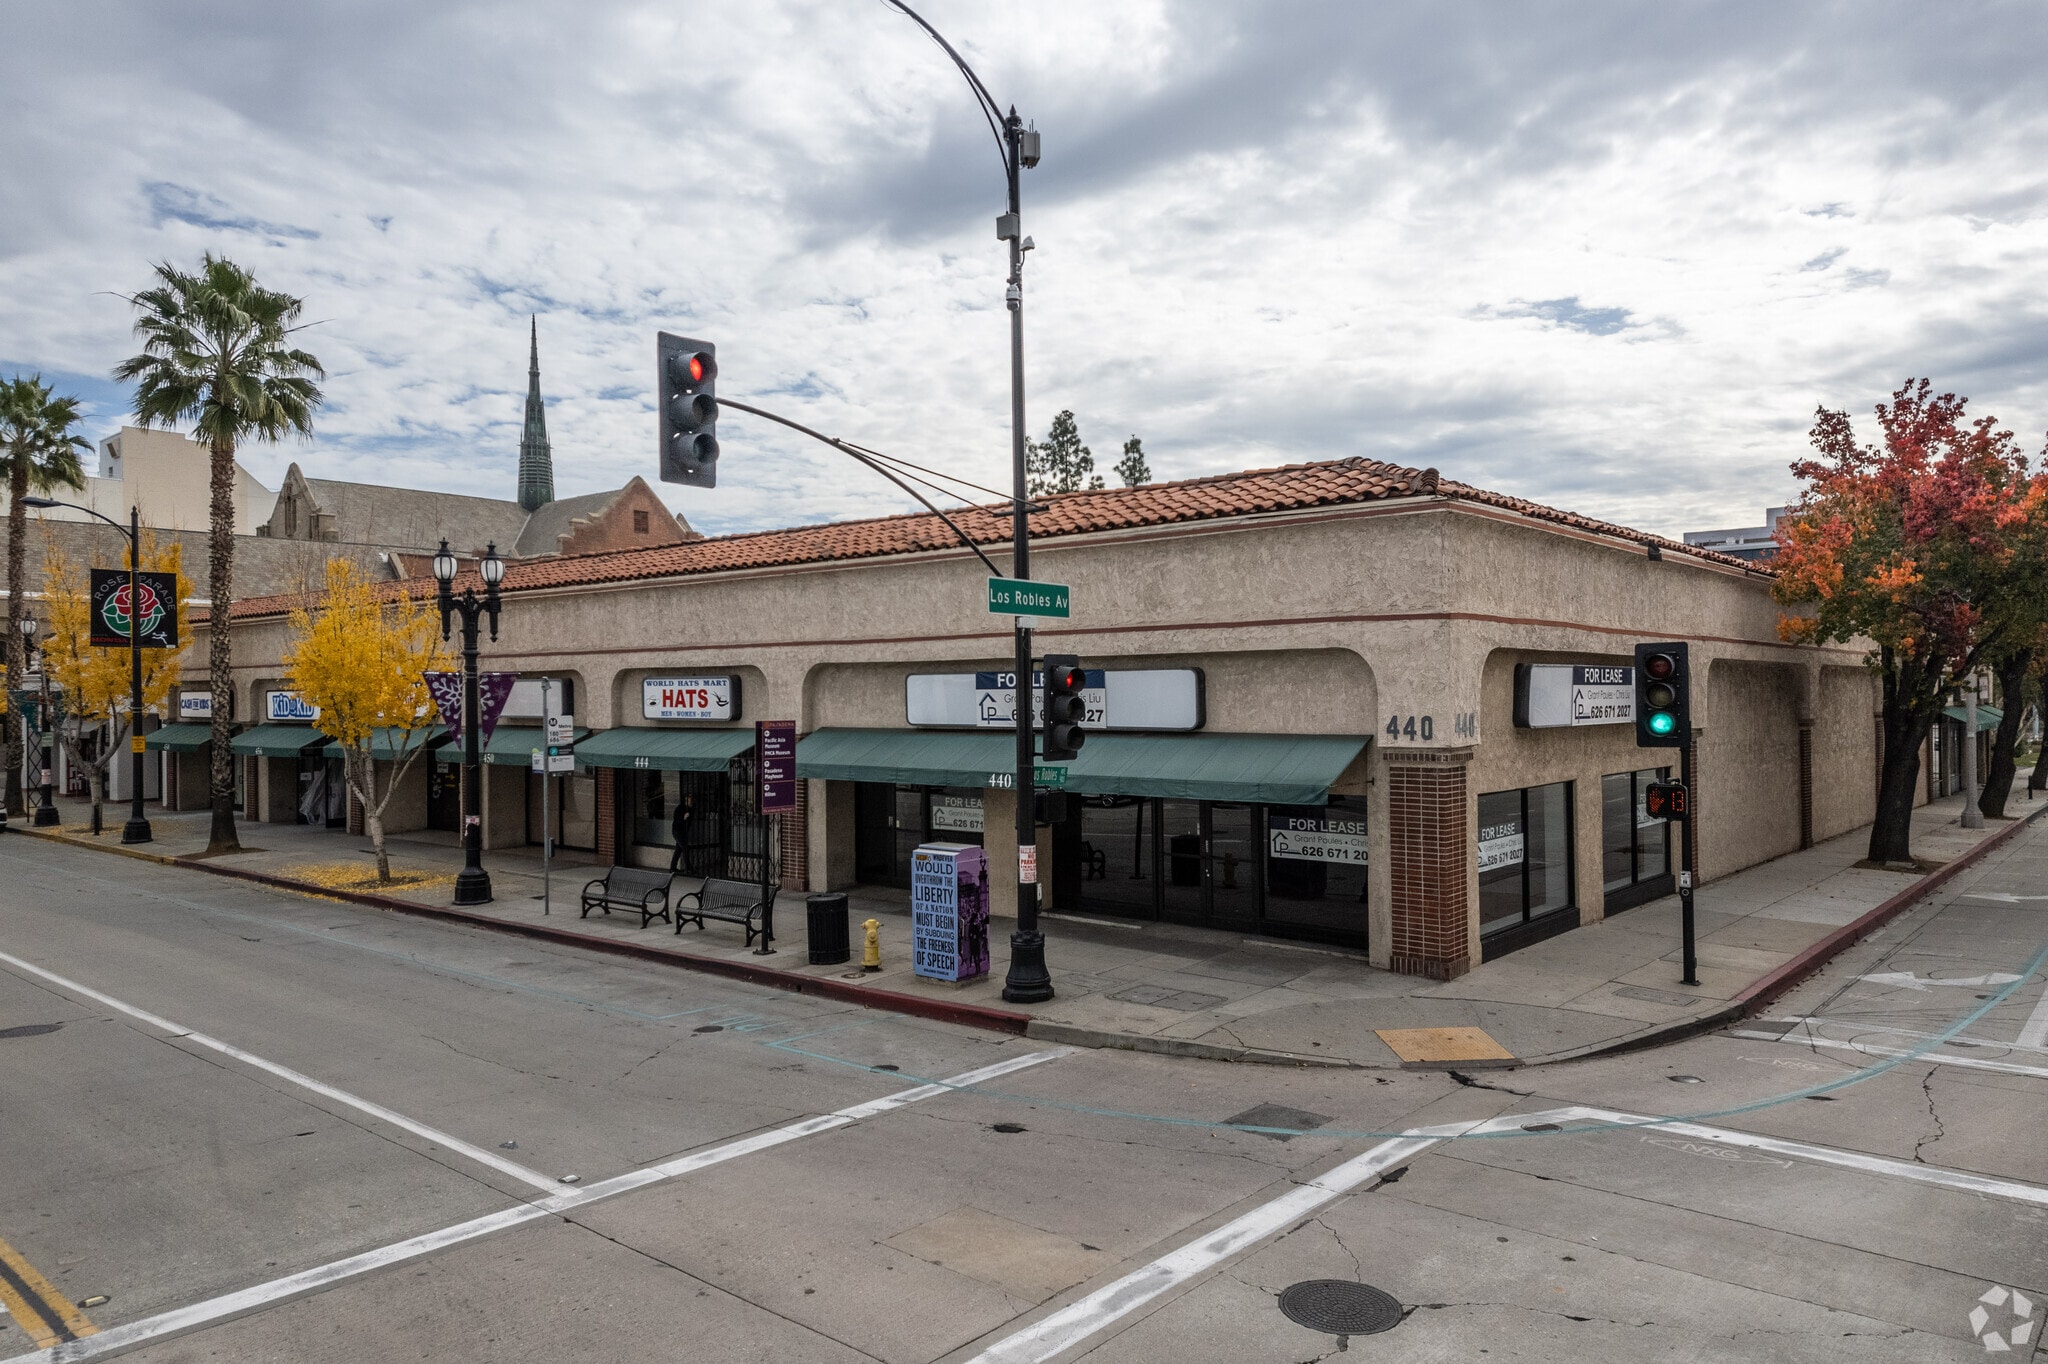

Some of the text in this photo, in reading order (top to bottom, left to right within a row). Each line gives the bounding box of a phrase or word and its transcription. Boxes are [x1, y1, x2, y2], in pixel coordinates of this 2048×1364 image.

[94, 575, 176, 611] ROSE PARADE
[990, 588, 1068, 608] Los Robles Av
[997, 673, 1016, 687] FO
[1584, 668, 1623, 683] FOR LEASE
[181, 699, 192, 709] CASH
[662, 689, 709, 709] HATS
[1089, 693, 1101, 703] Liu
[1591, 705, 1631, 719] 626 671 2027
[1386, 715, 1433, 741] 440
[1455, 713, 1475, 738] 440
[484, 754, 495, 763] 450
[634, 757, 649, 768] 444
[988, 774, 1012, 788] 440
[945, 797, 983, 808] FOR LEA
[1671, 791, 1685, 812] 13
[953, 819, 984, 830] 626 671
[1289, 819, 1366, 834] FOR LEASE
[1481, 823, 1515, 840] FOR LEASE
[1294, 834, 1317, 844] Grant
[1318, 836, 1343, 845] Paules
[1301, 846, 1368, 861] 626 671 20
[1499, 851, 1508, 863] 671
[1510, 848, 1523, 860] 2027
[915, 861, 954, 875] WOULD
[915, 873, 953, 888] OVERTHROW THE
[915, 885, 954, 905] LIBERTY
[915, 902, 924, 911] OF
[930, 904, 954, 915] NATION
[916, 912, 955, 930] MUST BEGIN
[916, 927, 955, 940] BY SUBDUING
[916, 937, 955, 954] THE FREENESS
[916, 951, 955, 971] OF SPEECH
[1681, 1143, 1741, 1159] NXG
